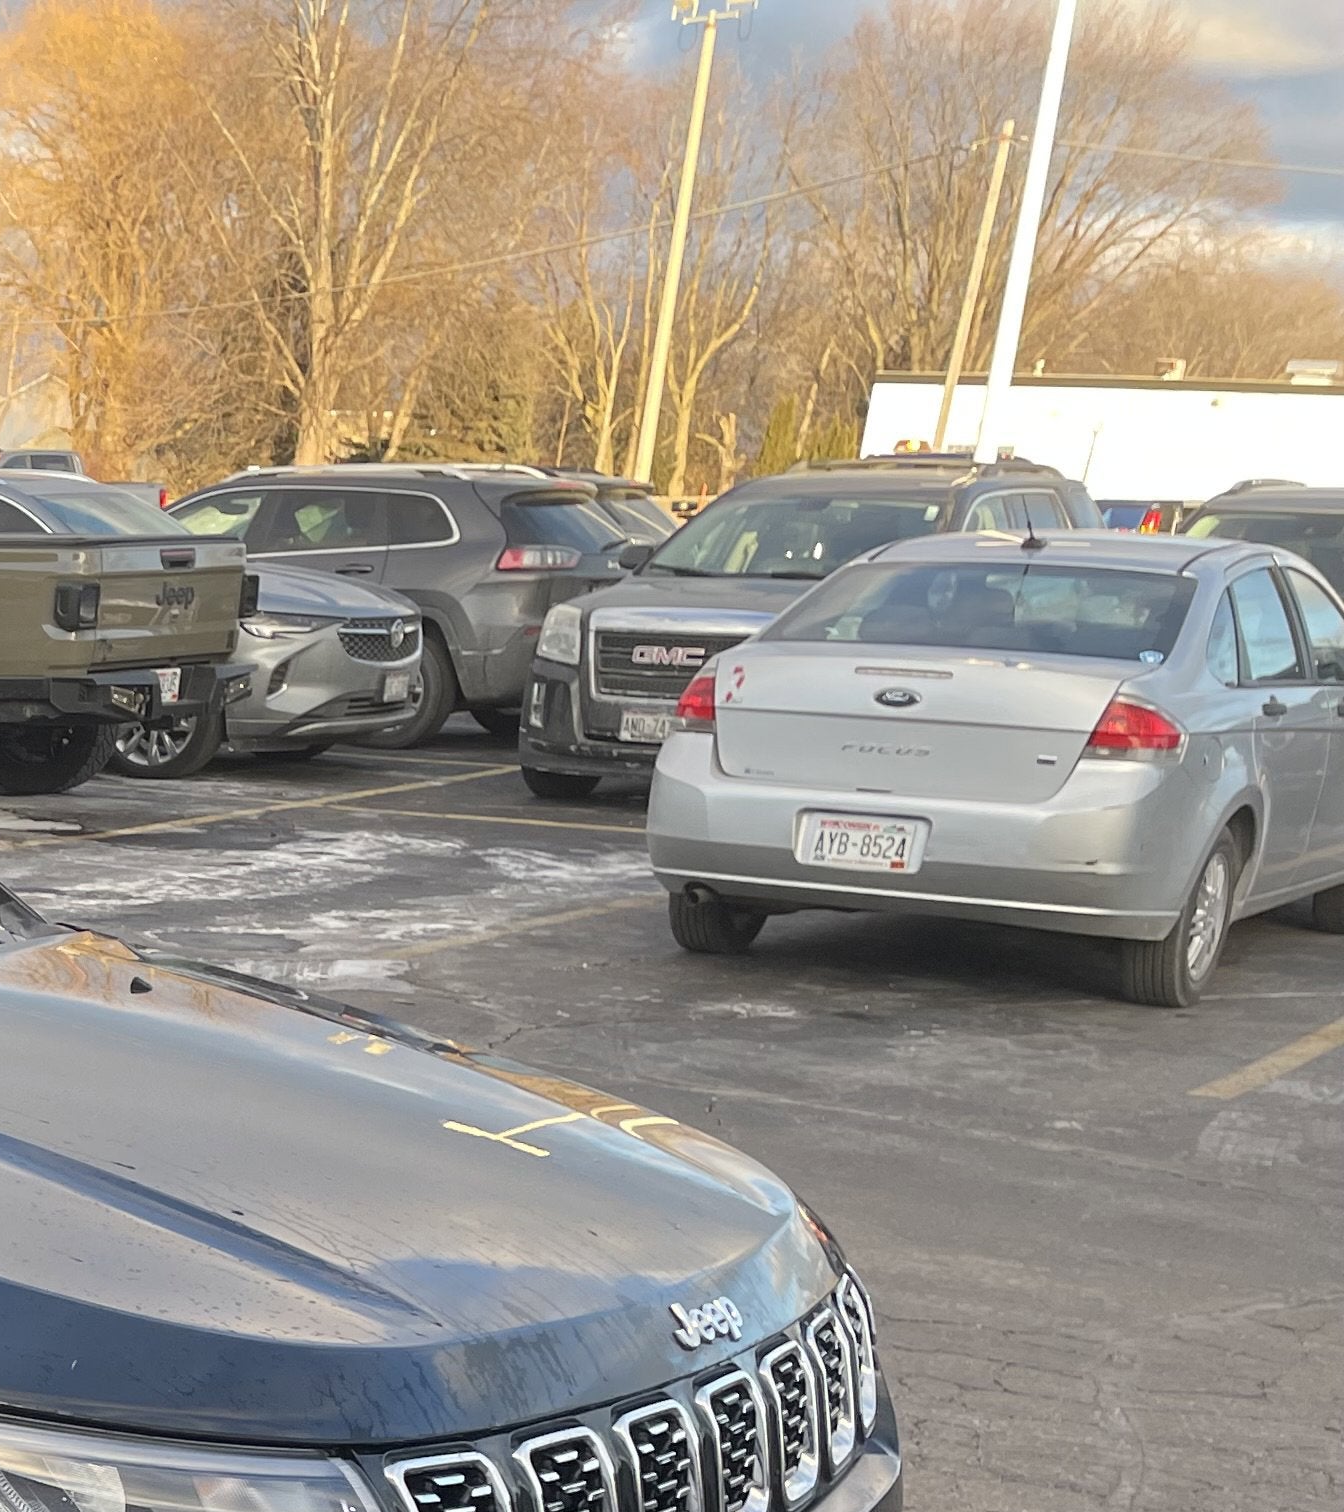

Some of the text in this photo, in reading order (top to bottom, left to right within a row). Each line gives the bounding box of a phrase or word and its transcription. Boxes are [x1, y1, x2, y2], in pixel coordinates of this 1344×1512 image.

[155, 581, 195, 609] Jeep
[631, 645, 706, 666] GMC
[623, 717, 670, 740] AND-74
[814, 830, 907, 860] AYB-8524
[670, 1296, 744, 1348] Jeep
